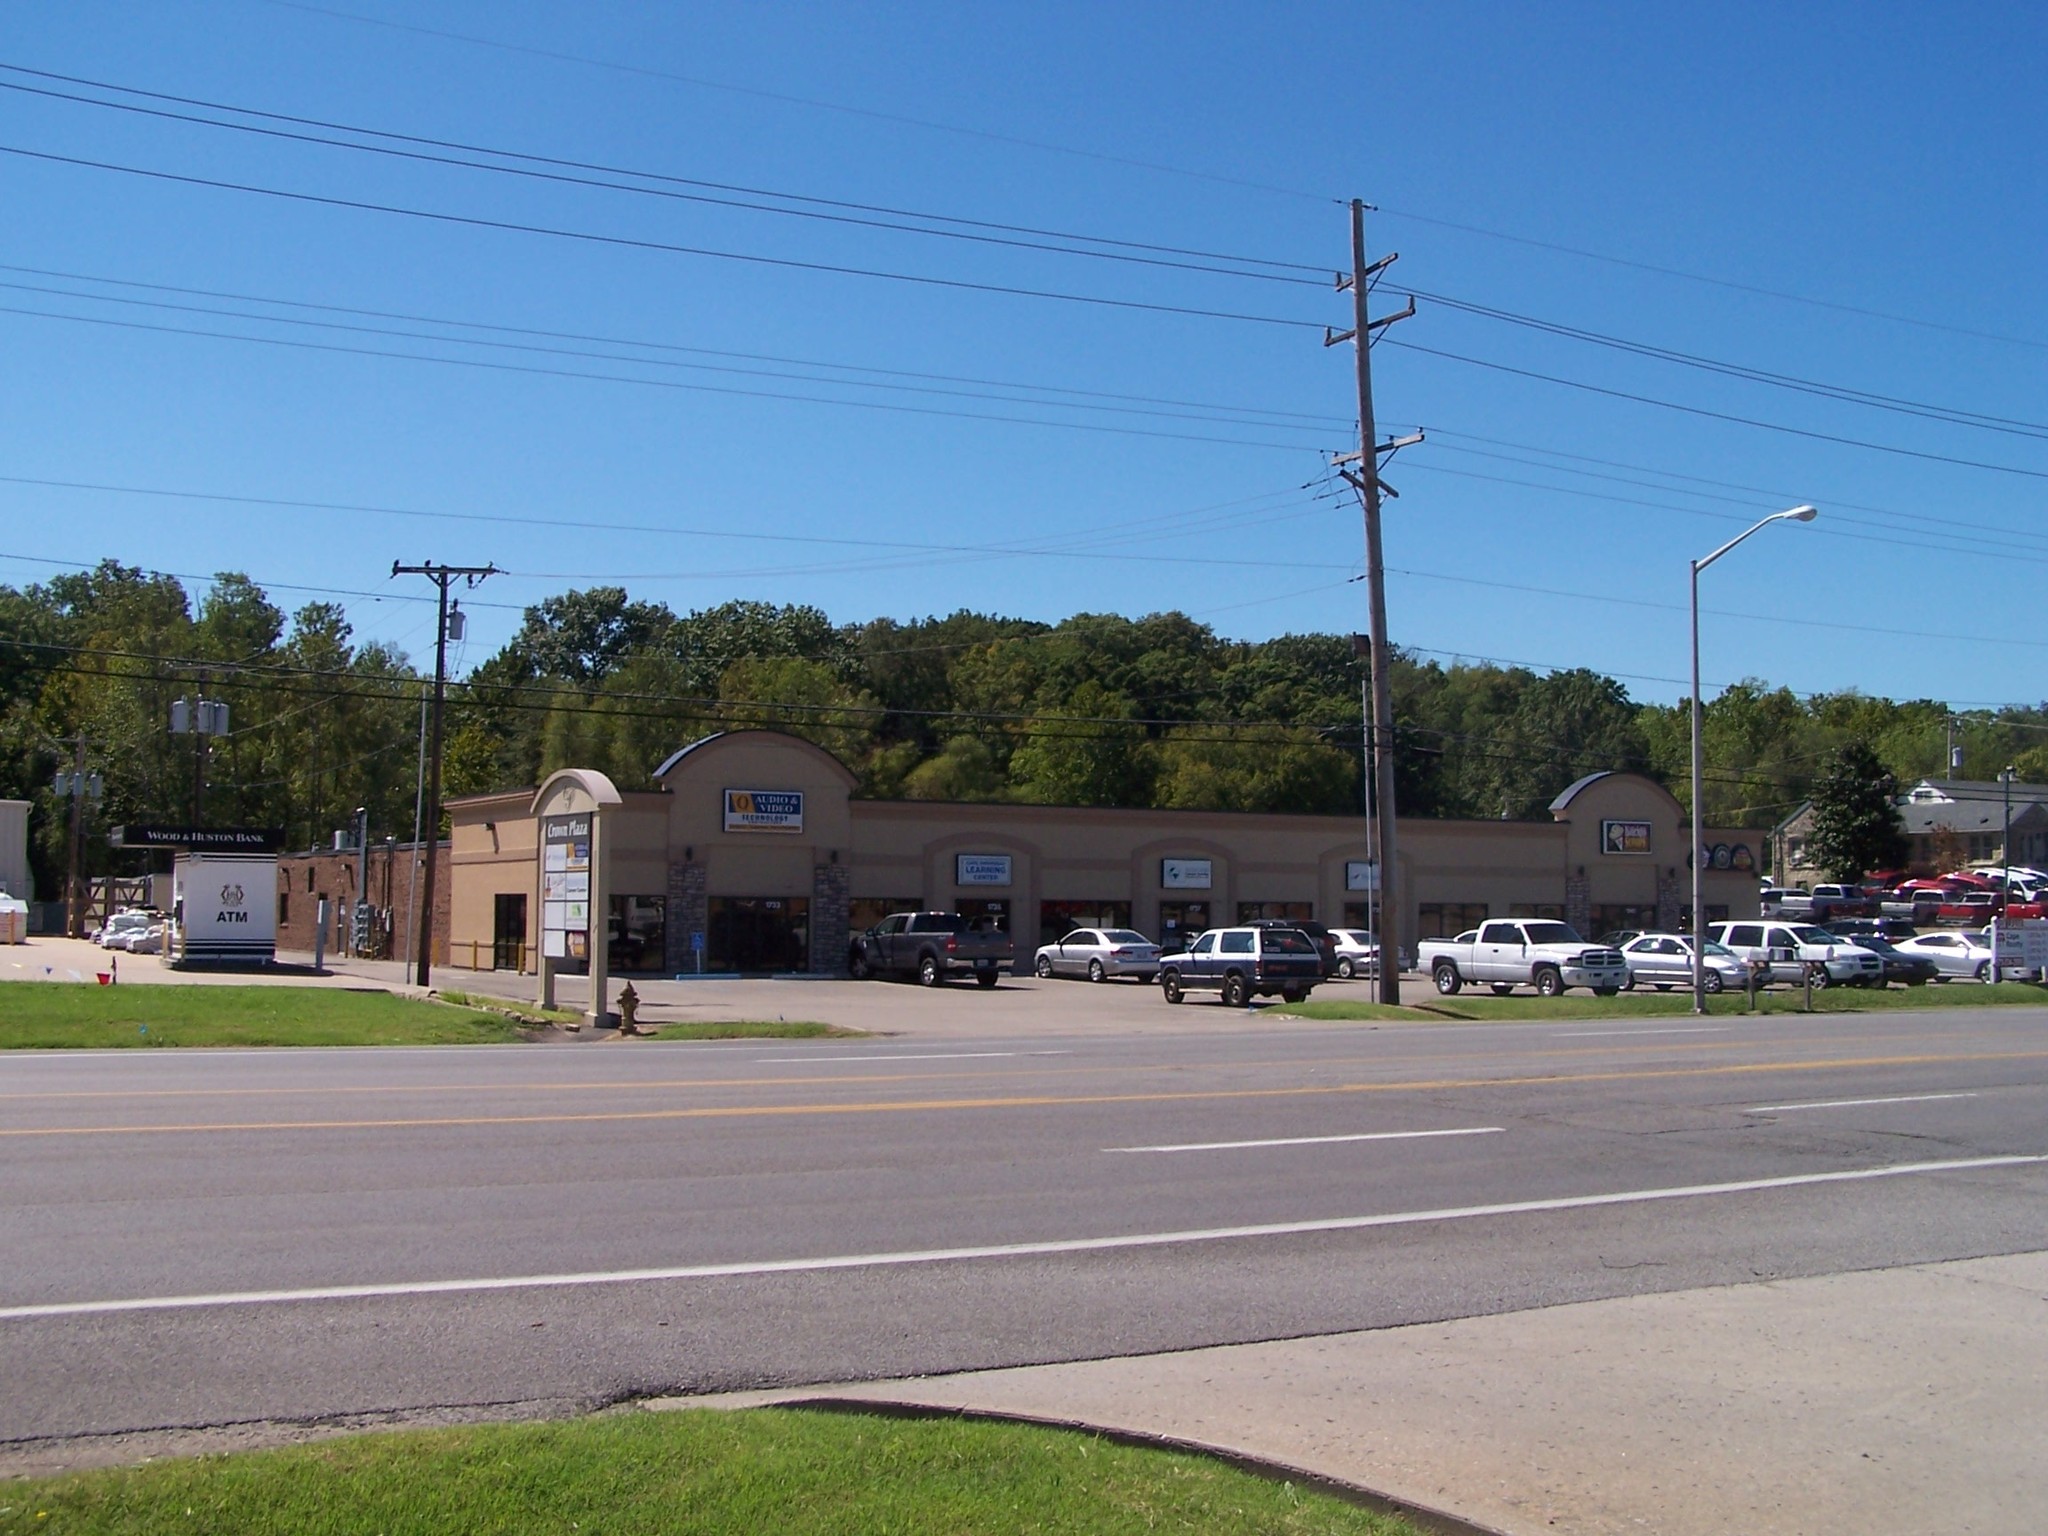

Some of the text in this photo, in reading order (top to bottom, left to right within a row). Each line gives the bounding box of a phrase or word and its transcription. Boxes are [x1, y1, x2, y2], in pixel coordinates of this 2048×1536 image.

[755, 795, 798, 804] AUDIO &
[760, 804, 794, 812] VIDEO
[547, 819, 588, 838] Crown Plaza
[147, 831, 264, 842] WOOD & HUSTON BANK
[965, 866, 1006, 874] LEARNING
[216, 911, 248, 923] ATM
